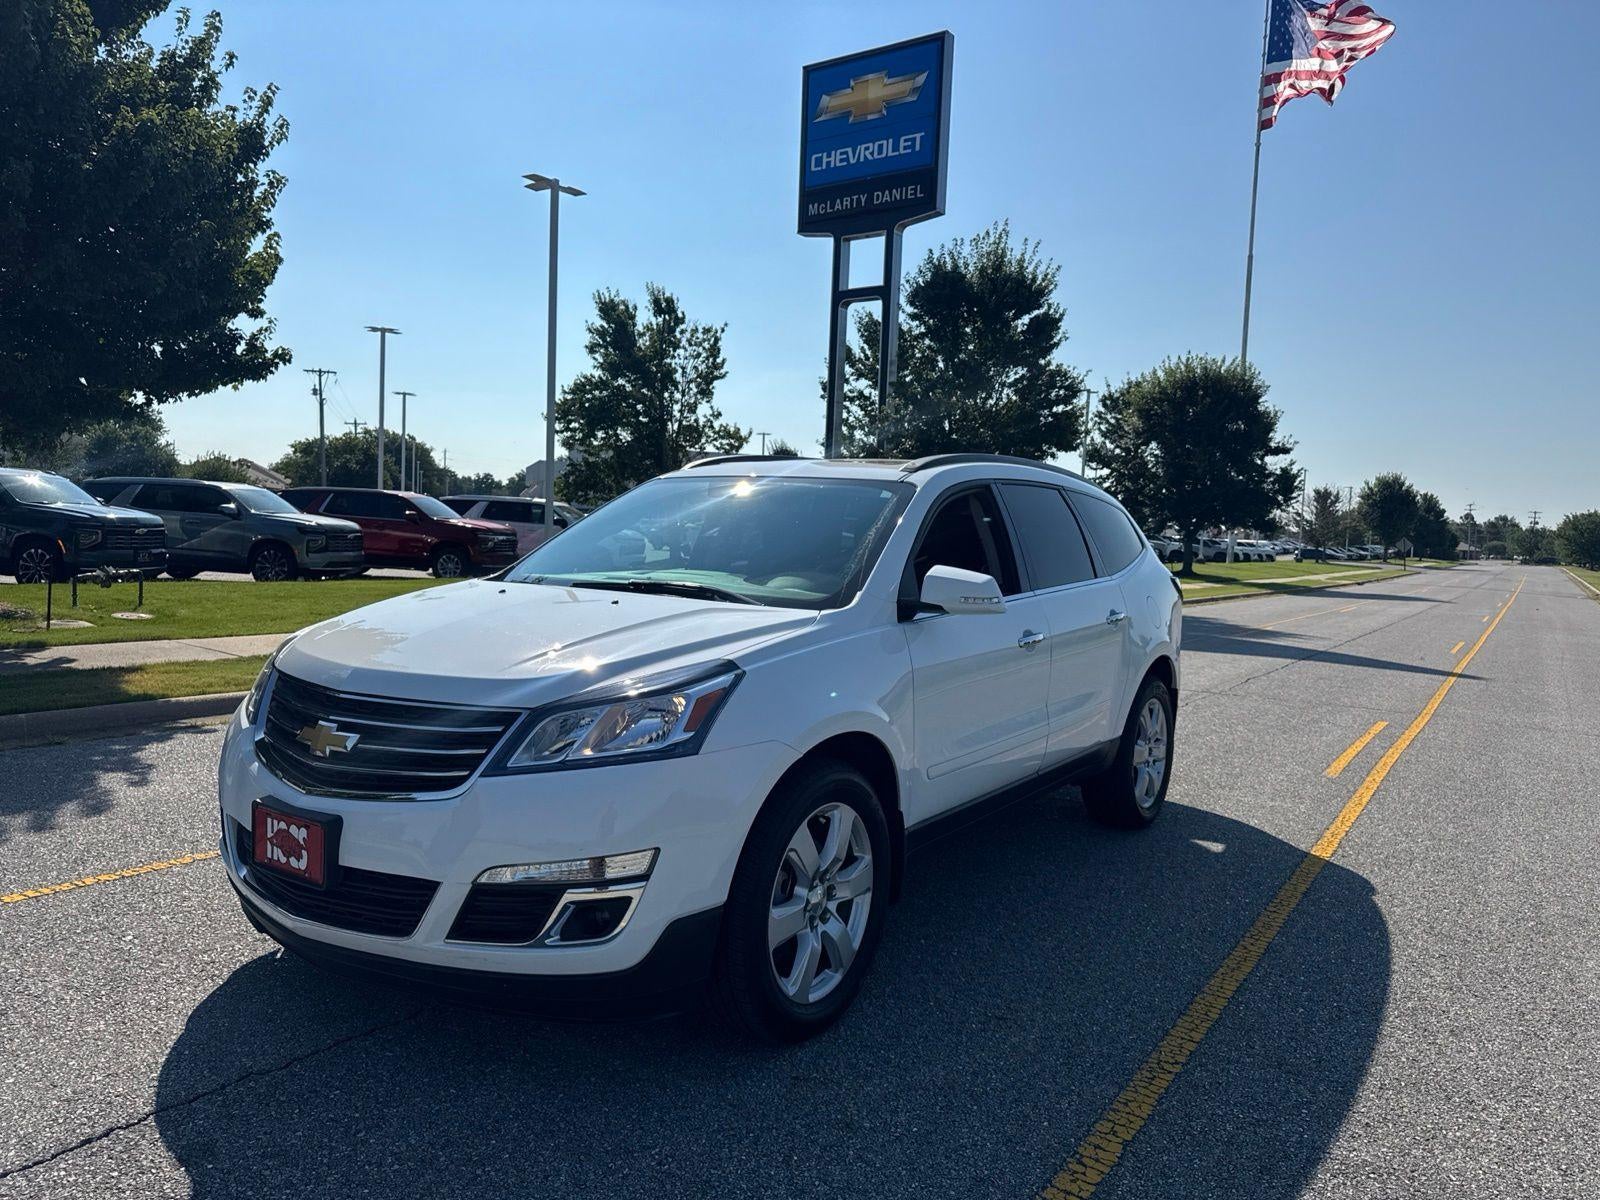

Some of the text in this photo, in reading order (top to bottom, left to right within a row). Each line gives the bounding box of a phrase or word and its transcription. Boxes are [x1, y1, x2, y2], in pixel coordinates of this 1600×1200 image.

[810, 132, 925, 172] CHEVROLET
[808, 184, 925, 216] McLARTY DANIEL
